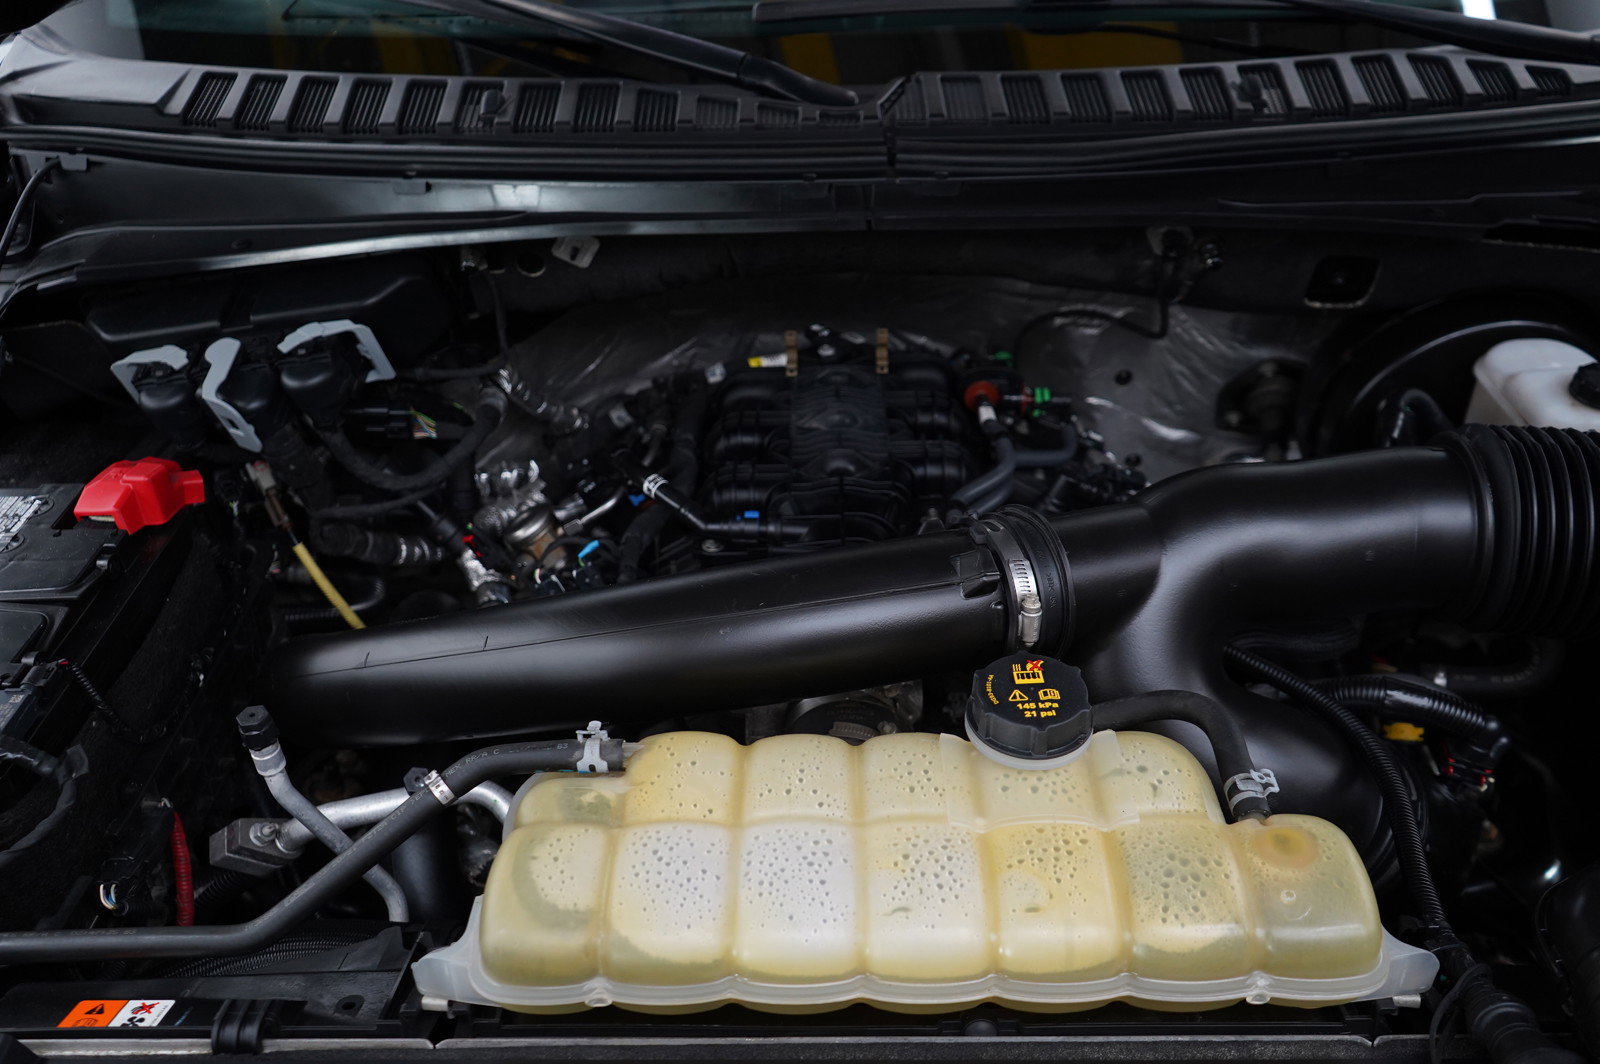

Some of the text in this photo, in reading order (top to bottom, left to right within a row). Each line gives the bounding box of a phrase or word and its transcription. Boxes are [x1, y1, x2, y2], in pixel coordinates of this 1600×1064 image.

[1016, 701, 1059, 710] 145 kPa
[1024, 709, 1057, 718] 21 psi
